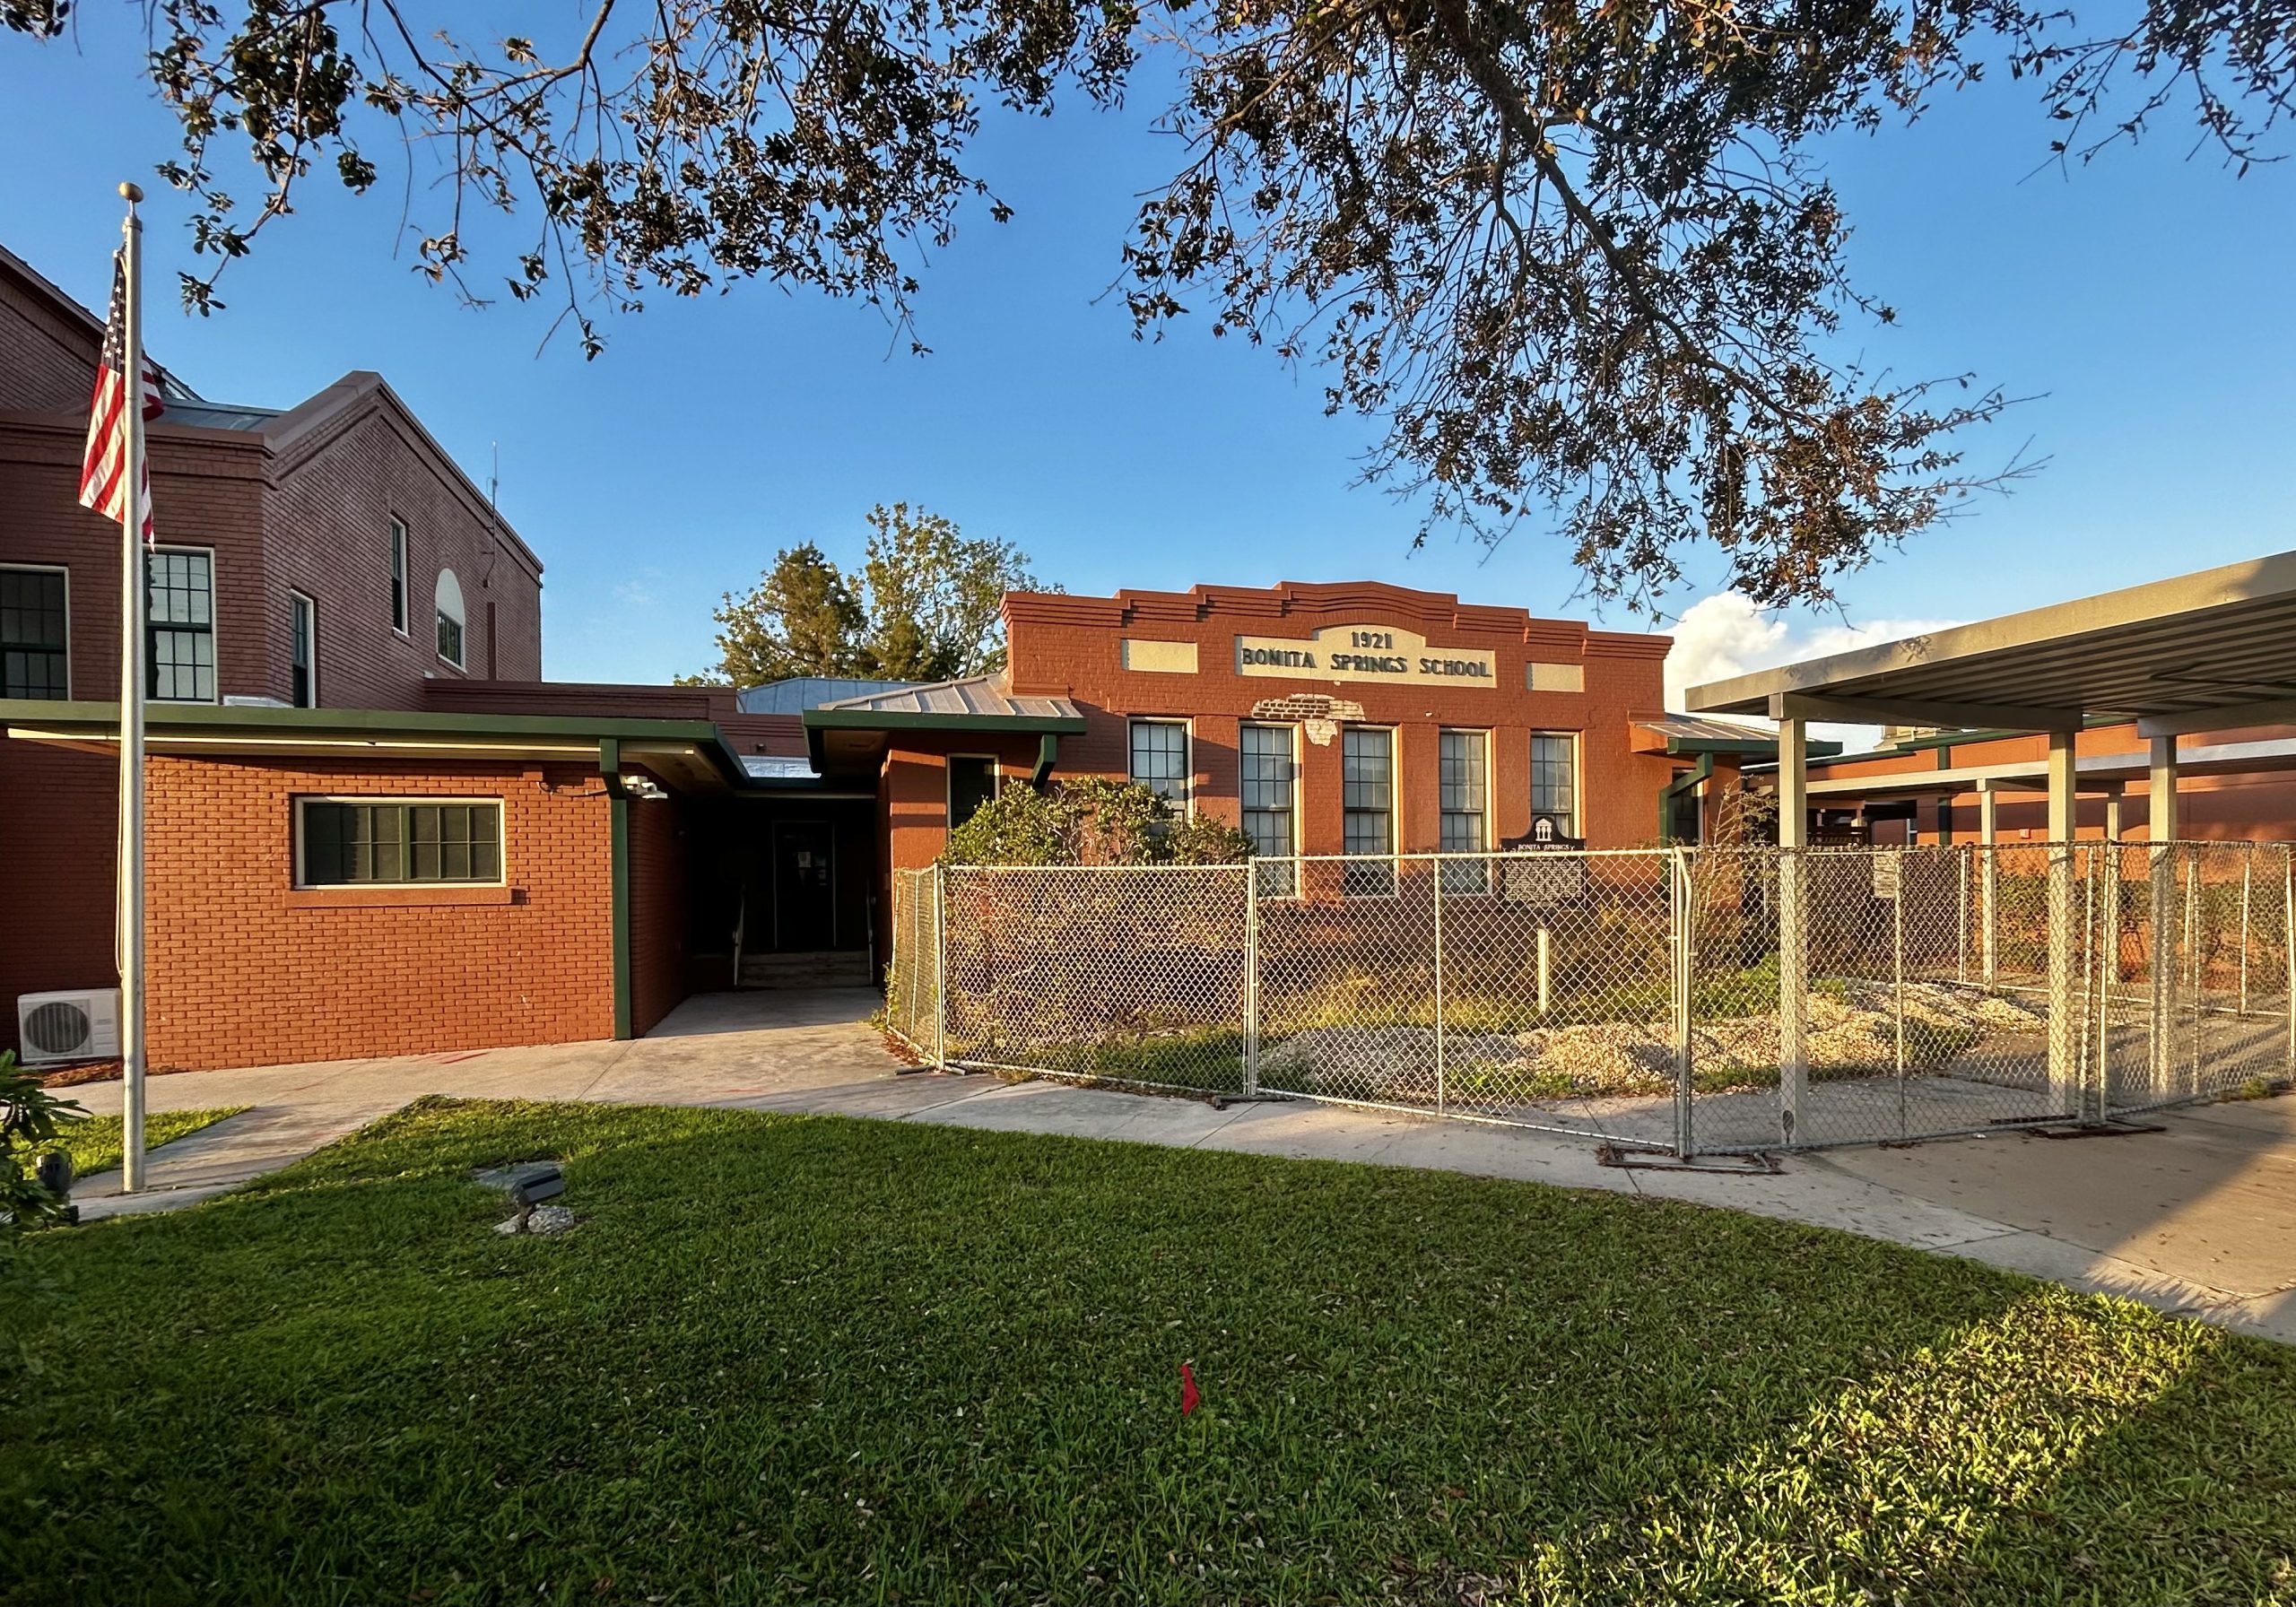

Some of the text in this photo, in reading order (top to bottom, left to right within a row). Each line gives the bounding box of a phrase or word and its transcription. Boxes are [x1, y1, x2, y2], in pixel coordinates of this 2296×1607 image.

[1352, 631, 1393, 649] 1921
[1242, 647, 1493, 677] BONITA SPRINGS SCHOOL
